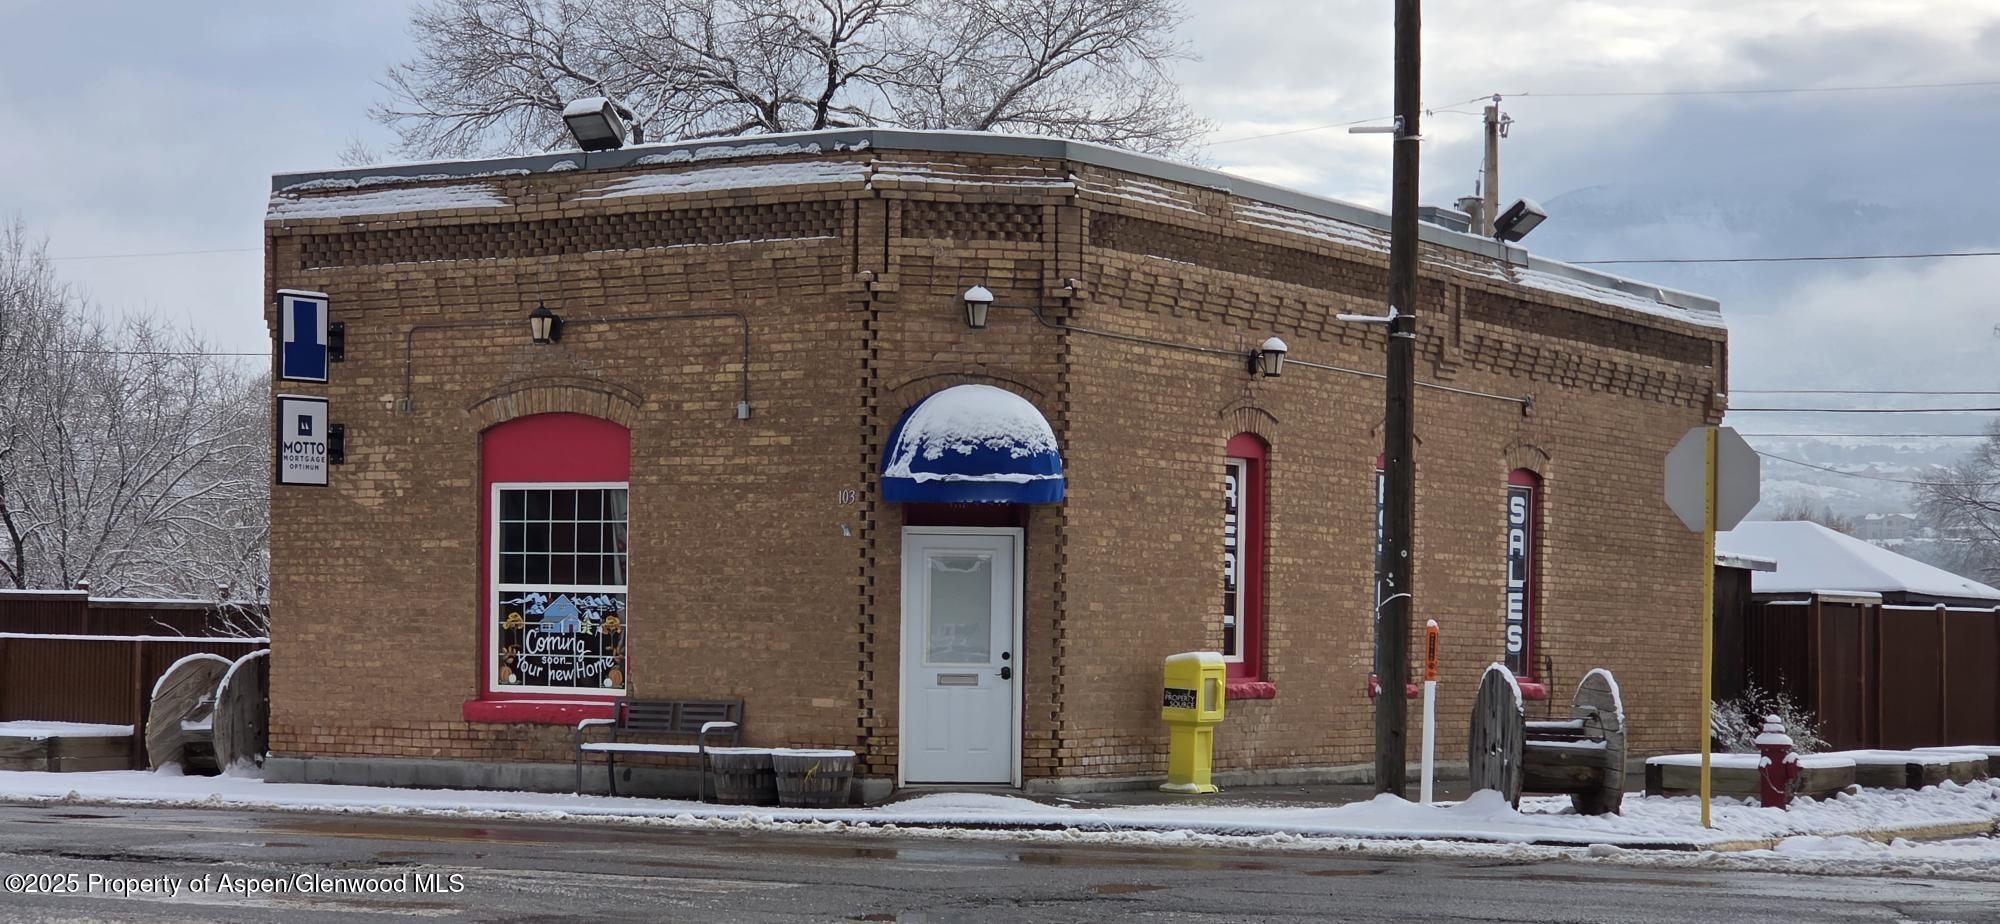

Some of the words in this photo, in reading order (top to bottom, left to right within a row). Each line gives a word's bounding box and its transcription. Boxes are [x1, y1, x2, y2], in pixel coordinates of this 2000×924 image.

[284, 441, 325, 455] MOTTO
[284, 455, 326, 463] MORTGAGE
[289, 463, 320, 471] OPTIMUM
[838, 489, 855, 505] 103
[1507, 496, 1526, 653] SALES
[525, 629, 591, 661] Coming
[516, 651, 543, 677] Your
[549, 667, 574, 681] new
[575, 655, 615, 679] Home
